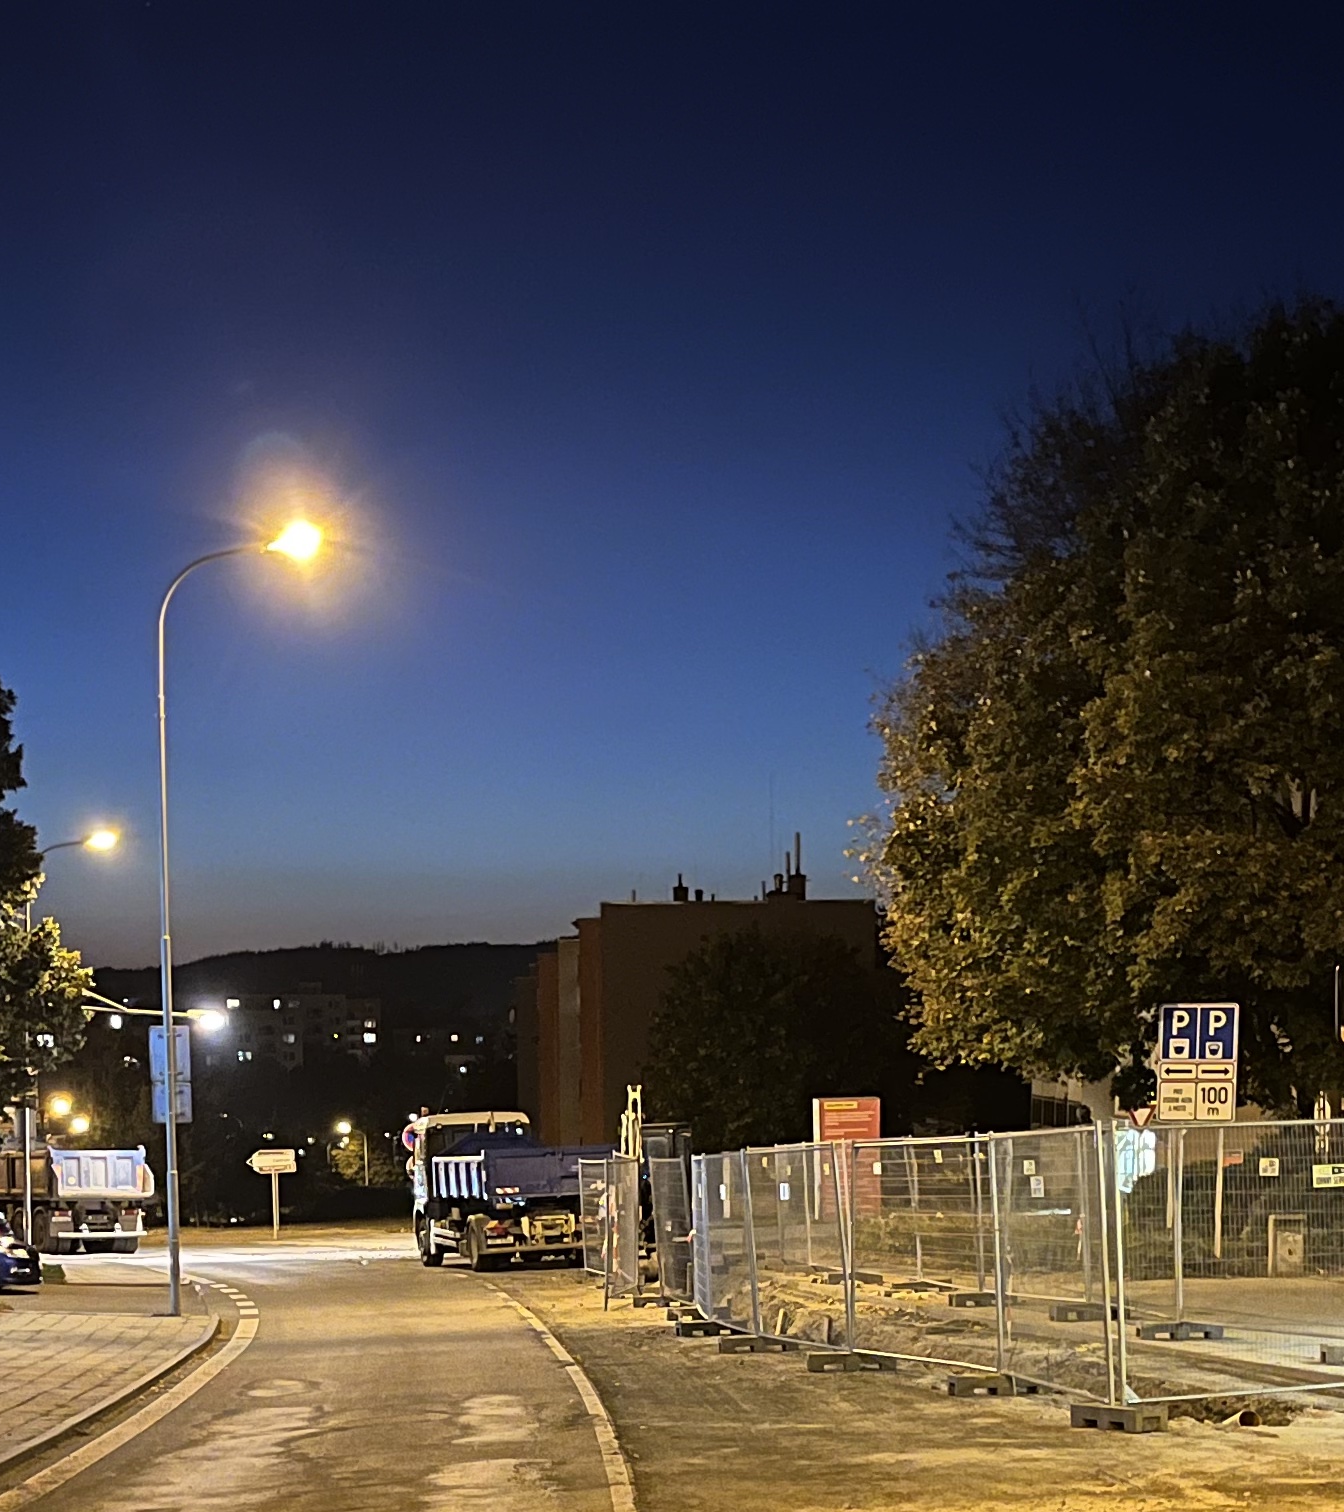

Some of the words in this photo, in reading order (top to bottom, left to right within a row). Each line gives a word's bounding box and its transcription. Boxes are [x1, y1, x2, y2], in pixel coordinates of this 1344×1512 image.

[1172, 1010, 1190, 1036] P
[1209, 1010, 1227, 1036] P
[1201, 1087, 1228, 1104] 100
[1207, 1107, 1219, 1116] m
